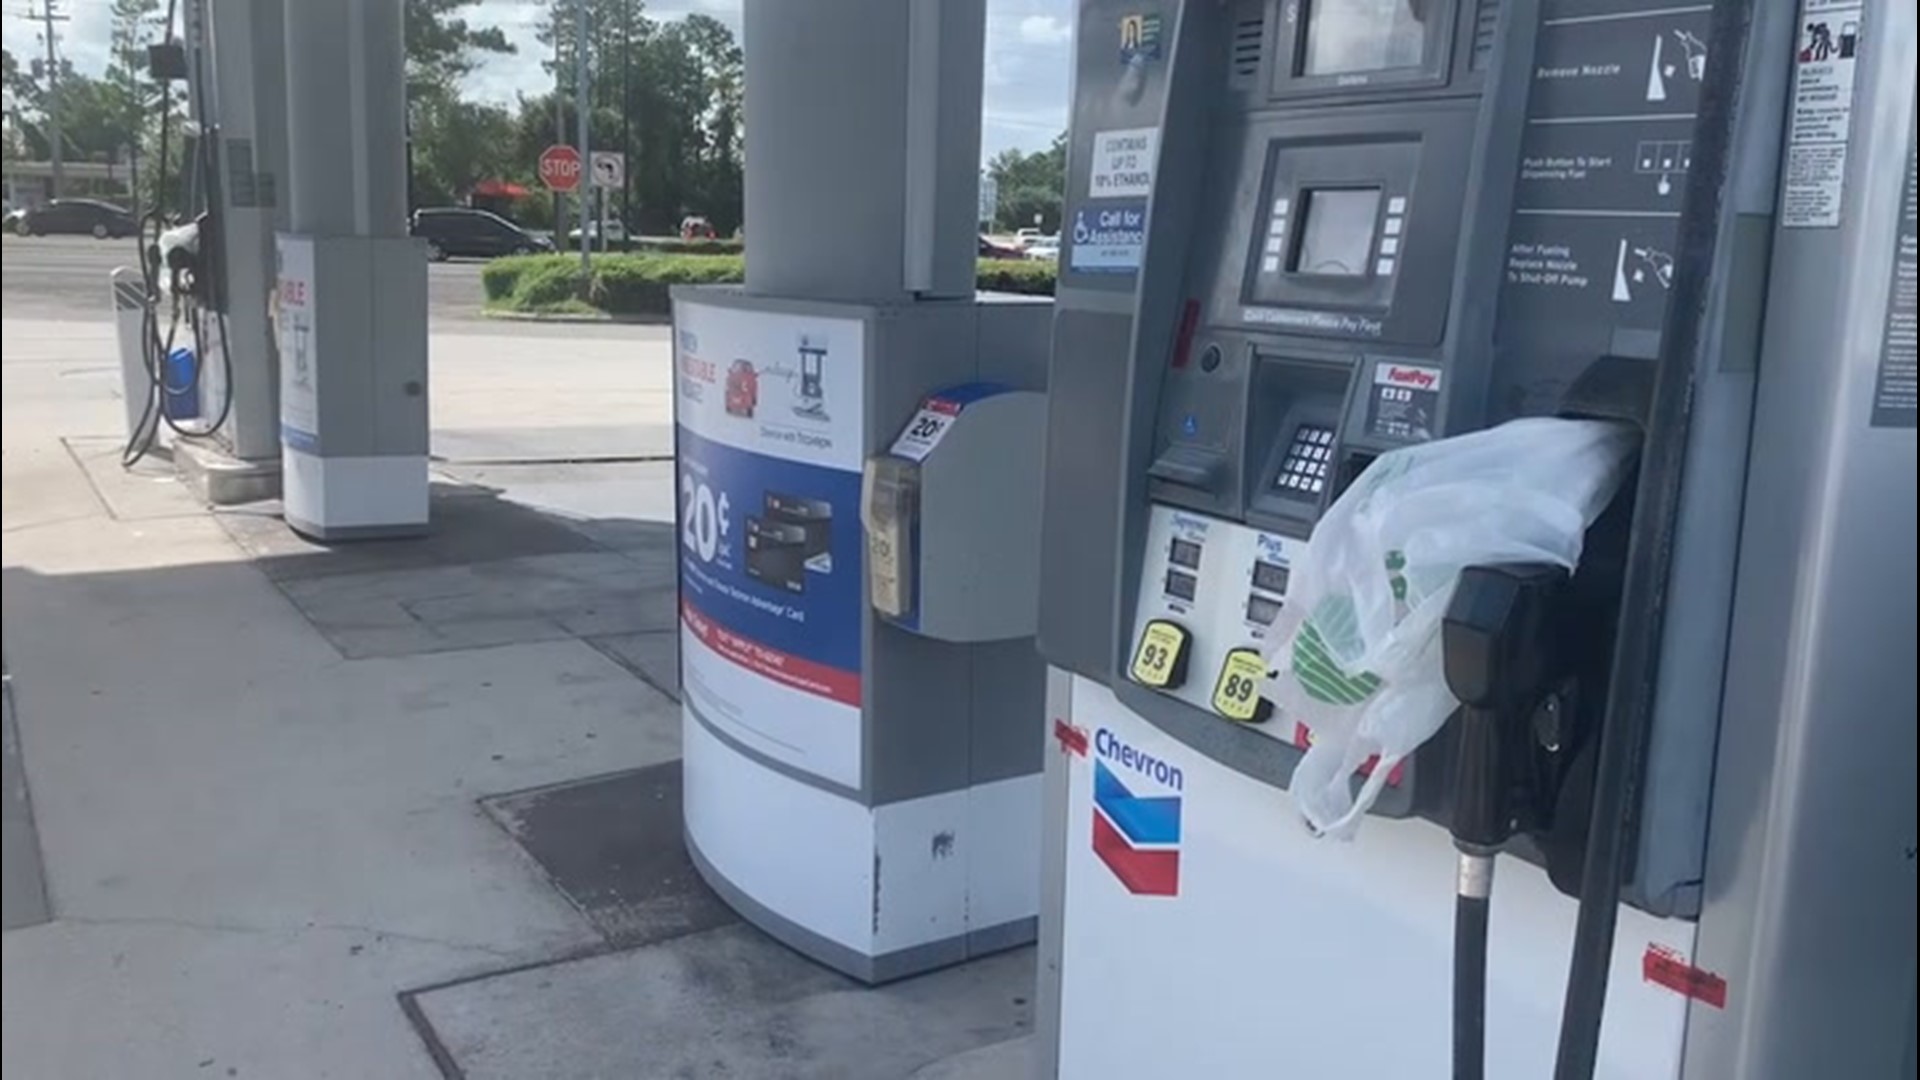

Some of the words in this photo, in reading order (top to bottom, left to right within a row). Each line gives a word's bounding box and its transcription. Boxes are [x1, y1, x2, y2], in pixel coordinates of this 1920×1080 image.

[1582, 64, 1620, 76] Nozzle
[543, 159, 581, 177] STOP
[1100, 210, 1122, 227] Call
[1123, 210, 1141, 226] for
[1560, 275, 1588, 288] Pump
[1340, 316, 1358, 333] Pay
[1257, 533, 1283, 553] Plus
[1142, 643, 1168, 671] 93
[1225, 673, 1253, 702] 89
[1094, 727, 1184, 792] Chevron
